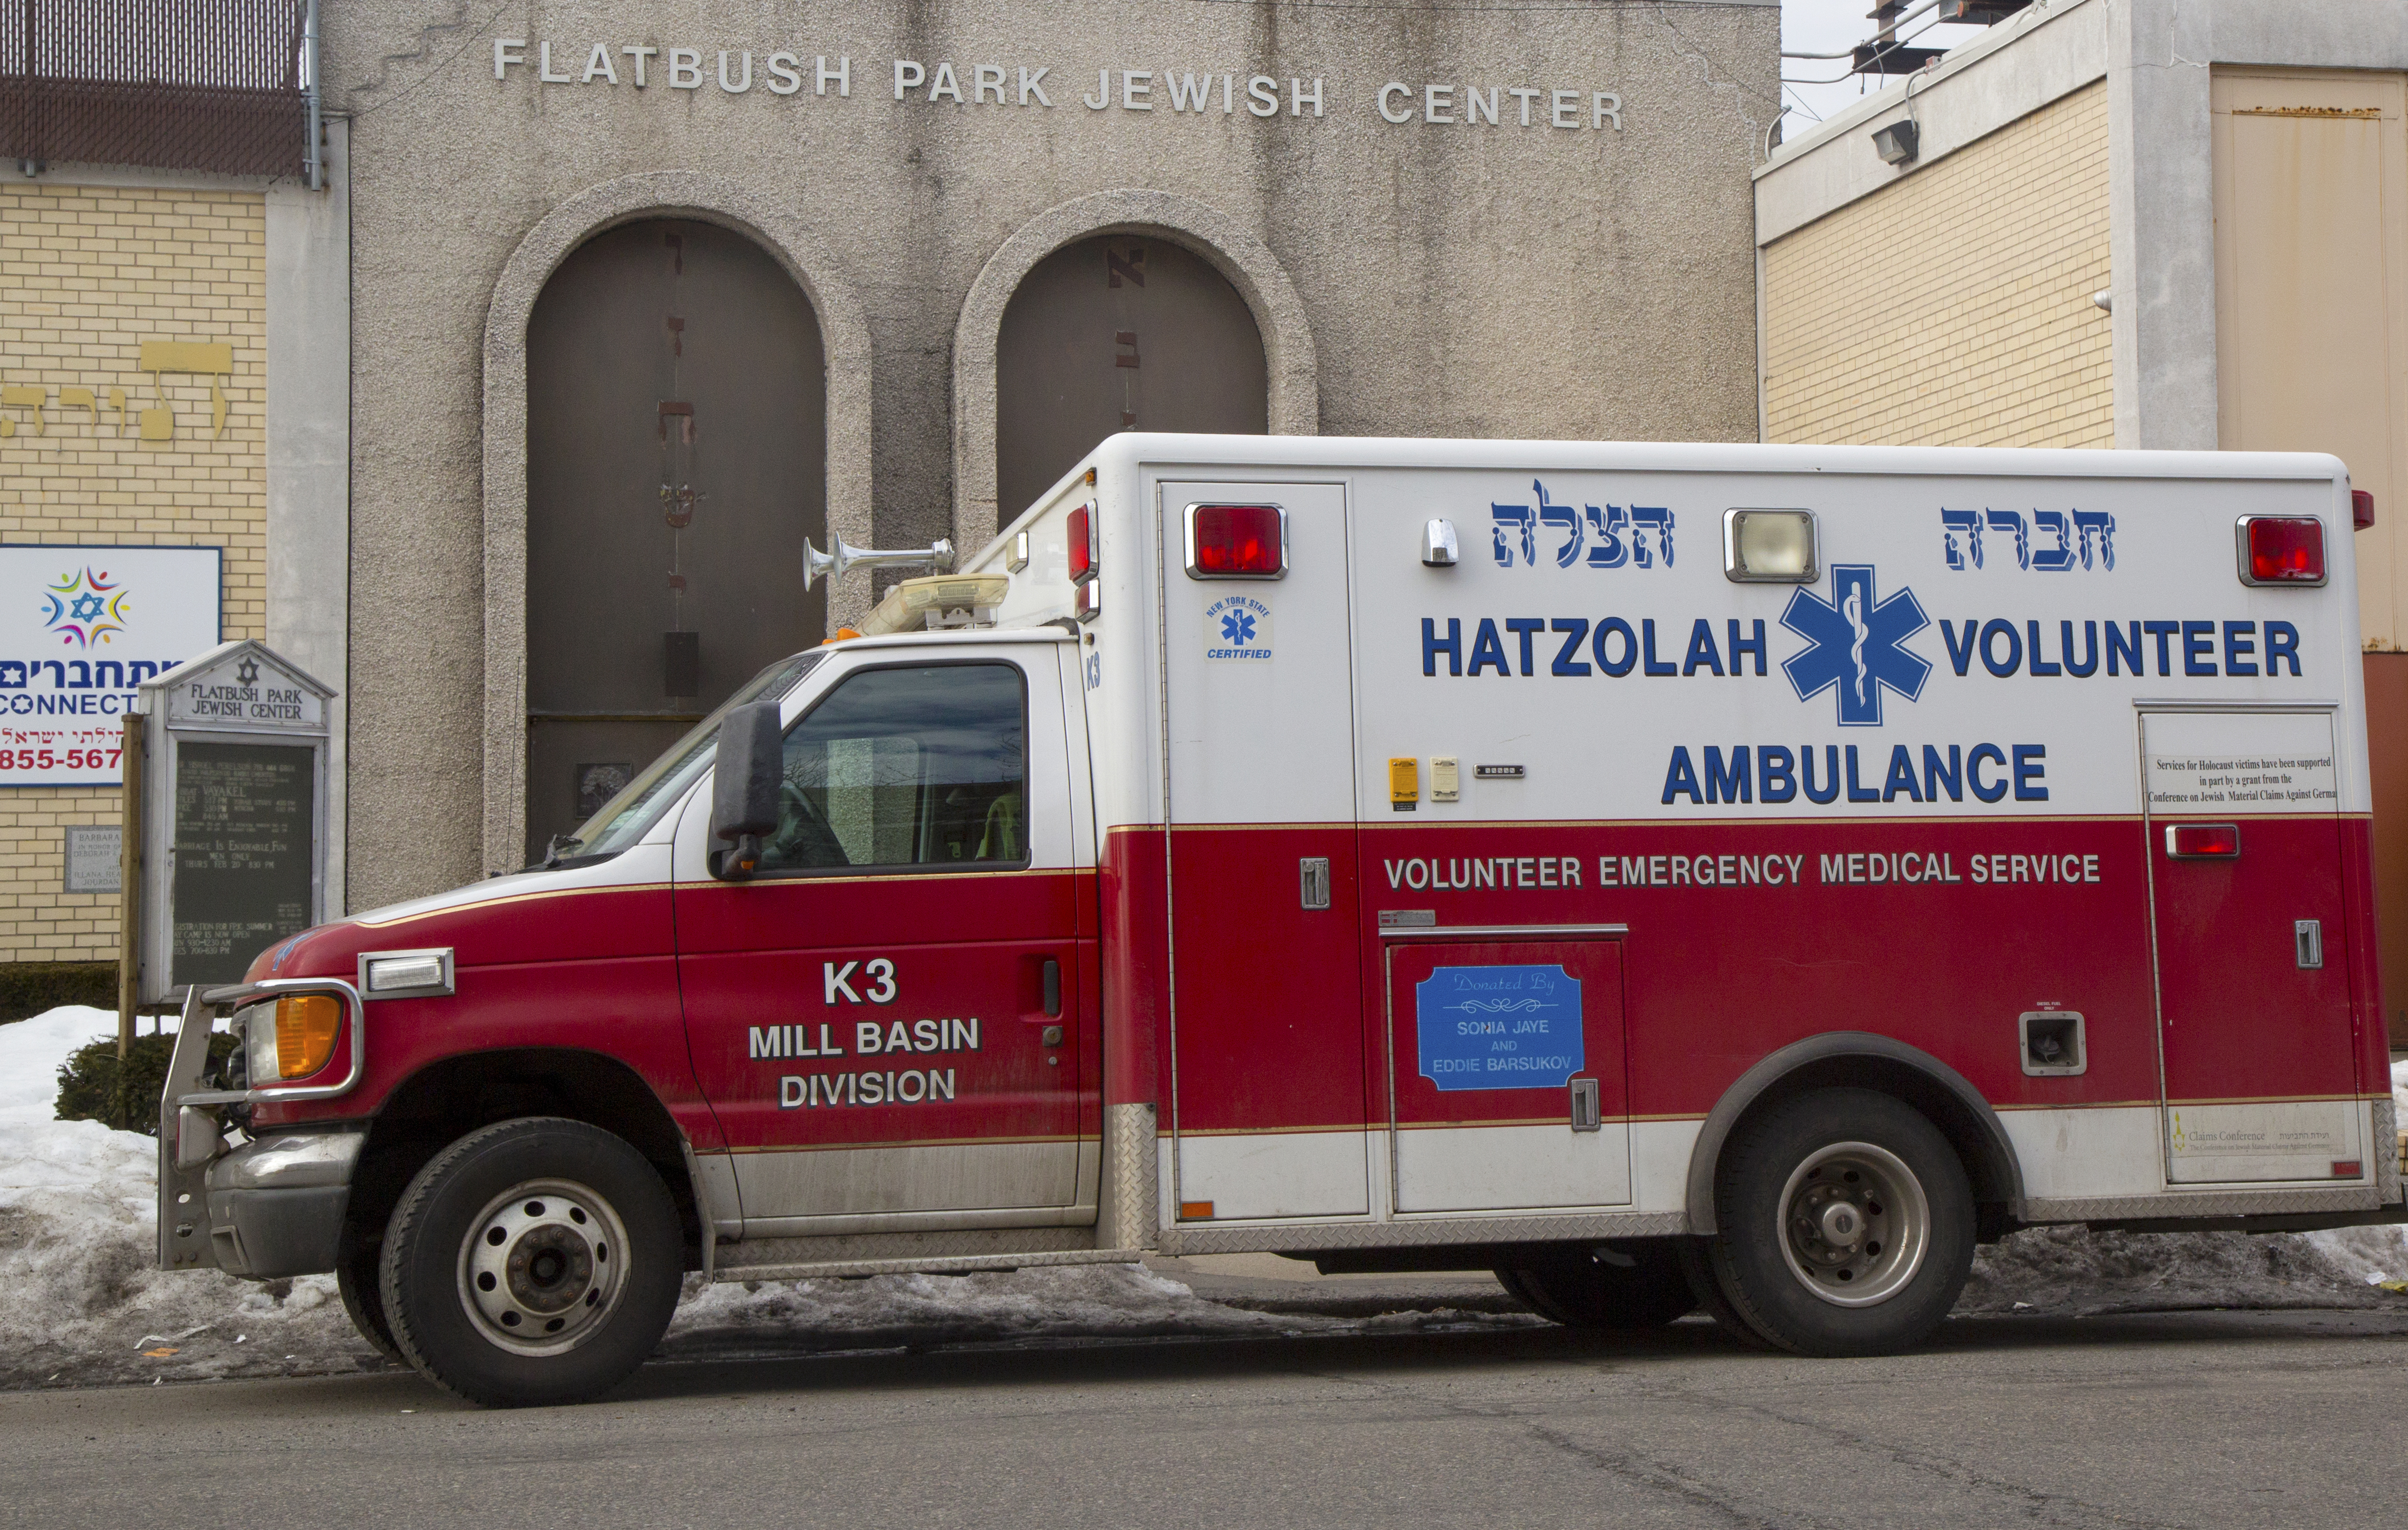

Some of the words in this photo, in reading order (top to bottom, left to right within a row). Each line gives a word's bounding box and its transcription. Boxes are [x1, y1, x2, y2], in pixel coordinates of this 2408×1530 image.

[494, 38, 850, 97] FLATBUSH
[894, 59, 1053, 106] PARK
[1083, 69, 1323, 117] JEWISH
[1378, 81, 1623, 131] CENTER
[1490, 478, 1676, 569] הצלה
[1940, 505, 2116, 572] חברה
[1206, 601, 1223, 618] NEW
[1225, 597, 1247, 606] YORK
[1248, 599, 1270, 618] STATE
[1207, 649, 1272, 659] CERTIFIED
[1421, 617, 1767, 678] HATZOLAH
[1938, 618, 2303, 678] VOLUNTEER
[0, 660, 185, 689] תחברים
[1086, 651, 1101, 692] K3
[191, 684, 258, 702] FLATBUSH
[267, 689, 303, 704] PARK
[192, 700, 243, 717] JEWISH
[250, 704, 302, 720] CENTER
[2, 727, 64, 744] ישראל
[0, 749, 123, 770] 855-567
[2157, 759, 2185, 770] Services
[2187, 760, 2197, 770] for
[2199, 760, 2233, 770] Holocaust
[2235, 759, 2260, 769] victims
[2261, 759, 2278, 769] have
[2279, 758, 2296, 768] been
[2297, 757, 2331, 770] supported
[1661, 743, 2049, 805] AMBULANCE
[2199, 776, 2207, 786] in
[2208, 777, 2224, 788] part
[2225, 775, 2234, 788] by
[2236, 778, 2241, 786] a
[2242, 775, 2261, 788] grant
[2262, 774, 2280, 784] from
[2281, 773, 2293, 784] the
[2148, 791, 2188, 803] Conference
[2190, 794, 2199, 802] on
[2200, 791, 2225, 803] Jewish
[2227, 790, 2259, 802] Material
[2260, 789, 2284, 801] Claims
[2285, 789, 2312, 802] Against
[79, 833, 120, 842] BARBARA
[1384, 857, 1583, 890] VOLUNTEER
[1599, 854, 1805, 888] EMERGENCY
[1820, 852, 1961, 885] MEDICAL
[1970, 853, 2101, 883] SERVICE
[183, 930, 203, 939] CAMP
[823, 958, 900, 1007] K3
[1454, 972, 1524, 991] Donated
[1529, 972, 1555, 996] By
[1457, 1021, 1507, 1036] SONIA
[1513, 1020, 1549, 1034] JAYE
[749, 1024, 847, 1061] MILL
[857, 1018, 982, 1055] BASIN
[1490, 1040, 1518, 1052] AND
[1433, 1058, 1481, 1073] EDDIE
[1487, 1056, 1572, 1071] BARSUKOV
[779, 1068, 956, 1109] DIVISION
[2189, 1131, 2218, 1141] Claims
[2219, 1130, 2265, 1141] Conference
